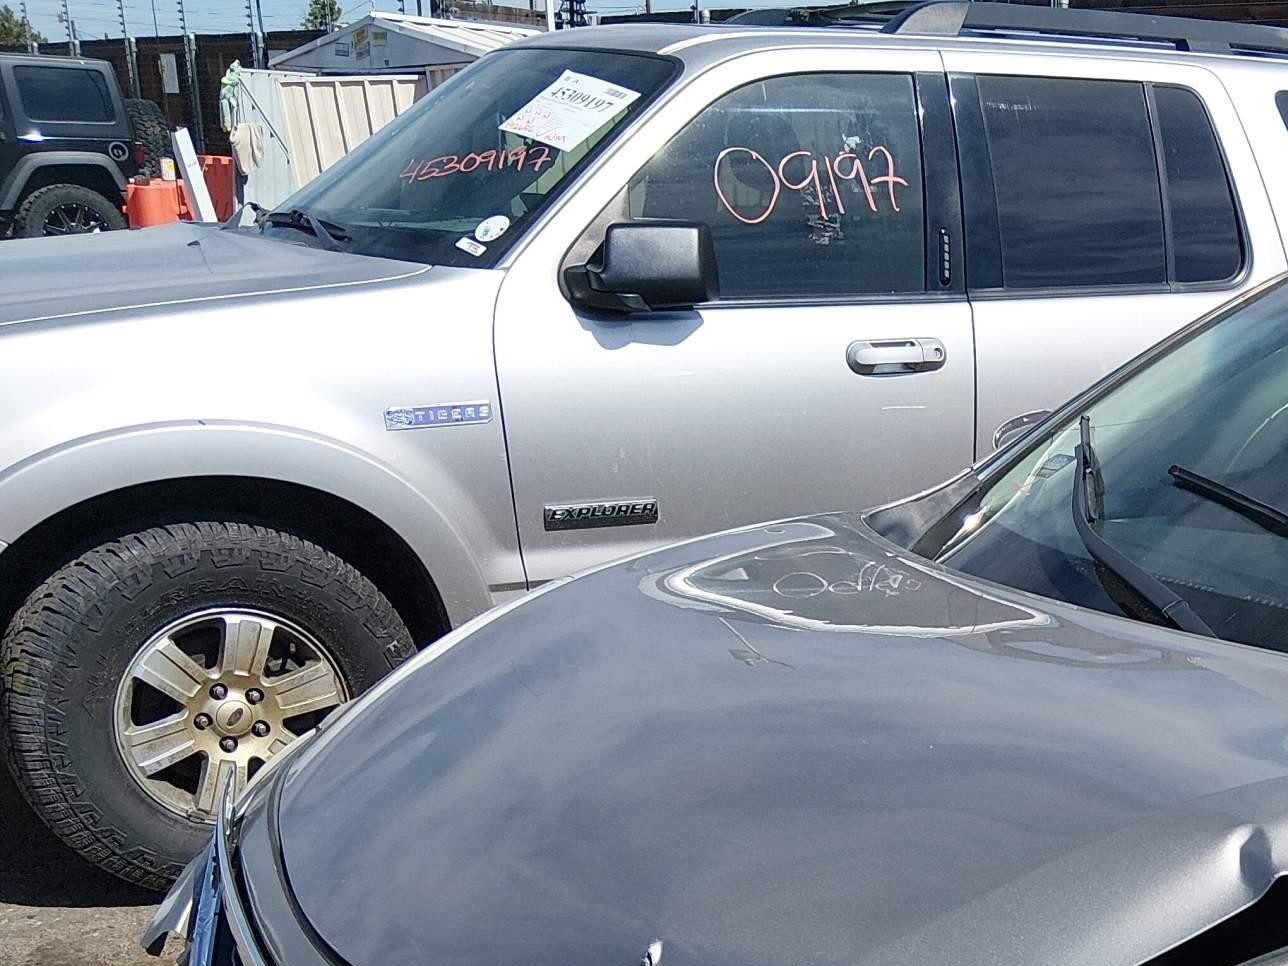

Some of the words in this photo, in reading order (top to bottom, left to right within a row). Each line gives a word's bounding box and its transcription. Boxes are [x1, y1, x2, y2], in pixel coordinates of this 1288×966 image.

[551, 87, 614, 113] 45309197
[399, 145, 552, 185] 45309197
[713, 146, 910, 225] 09197
[550, 502, 656, 521] EXPLORER
